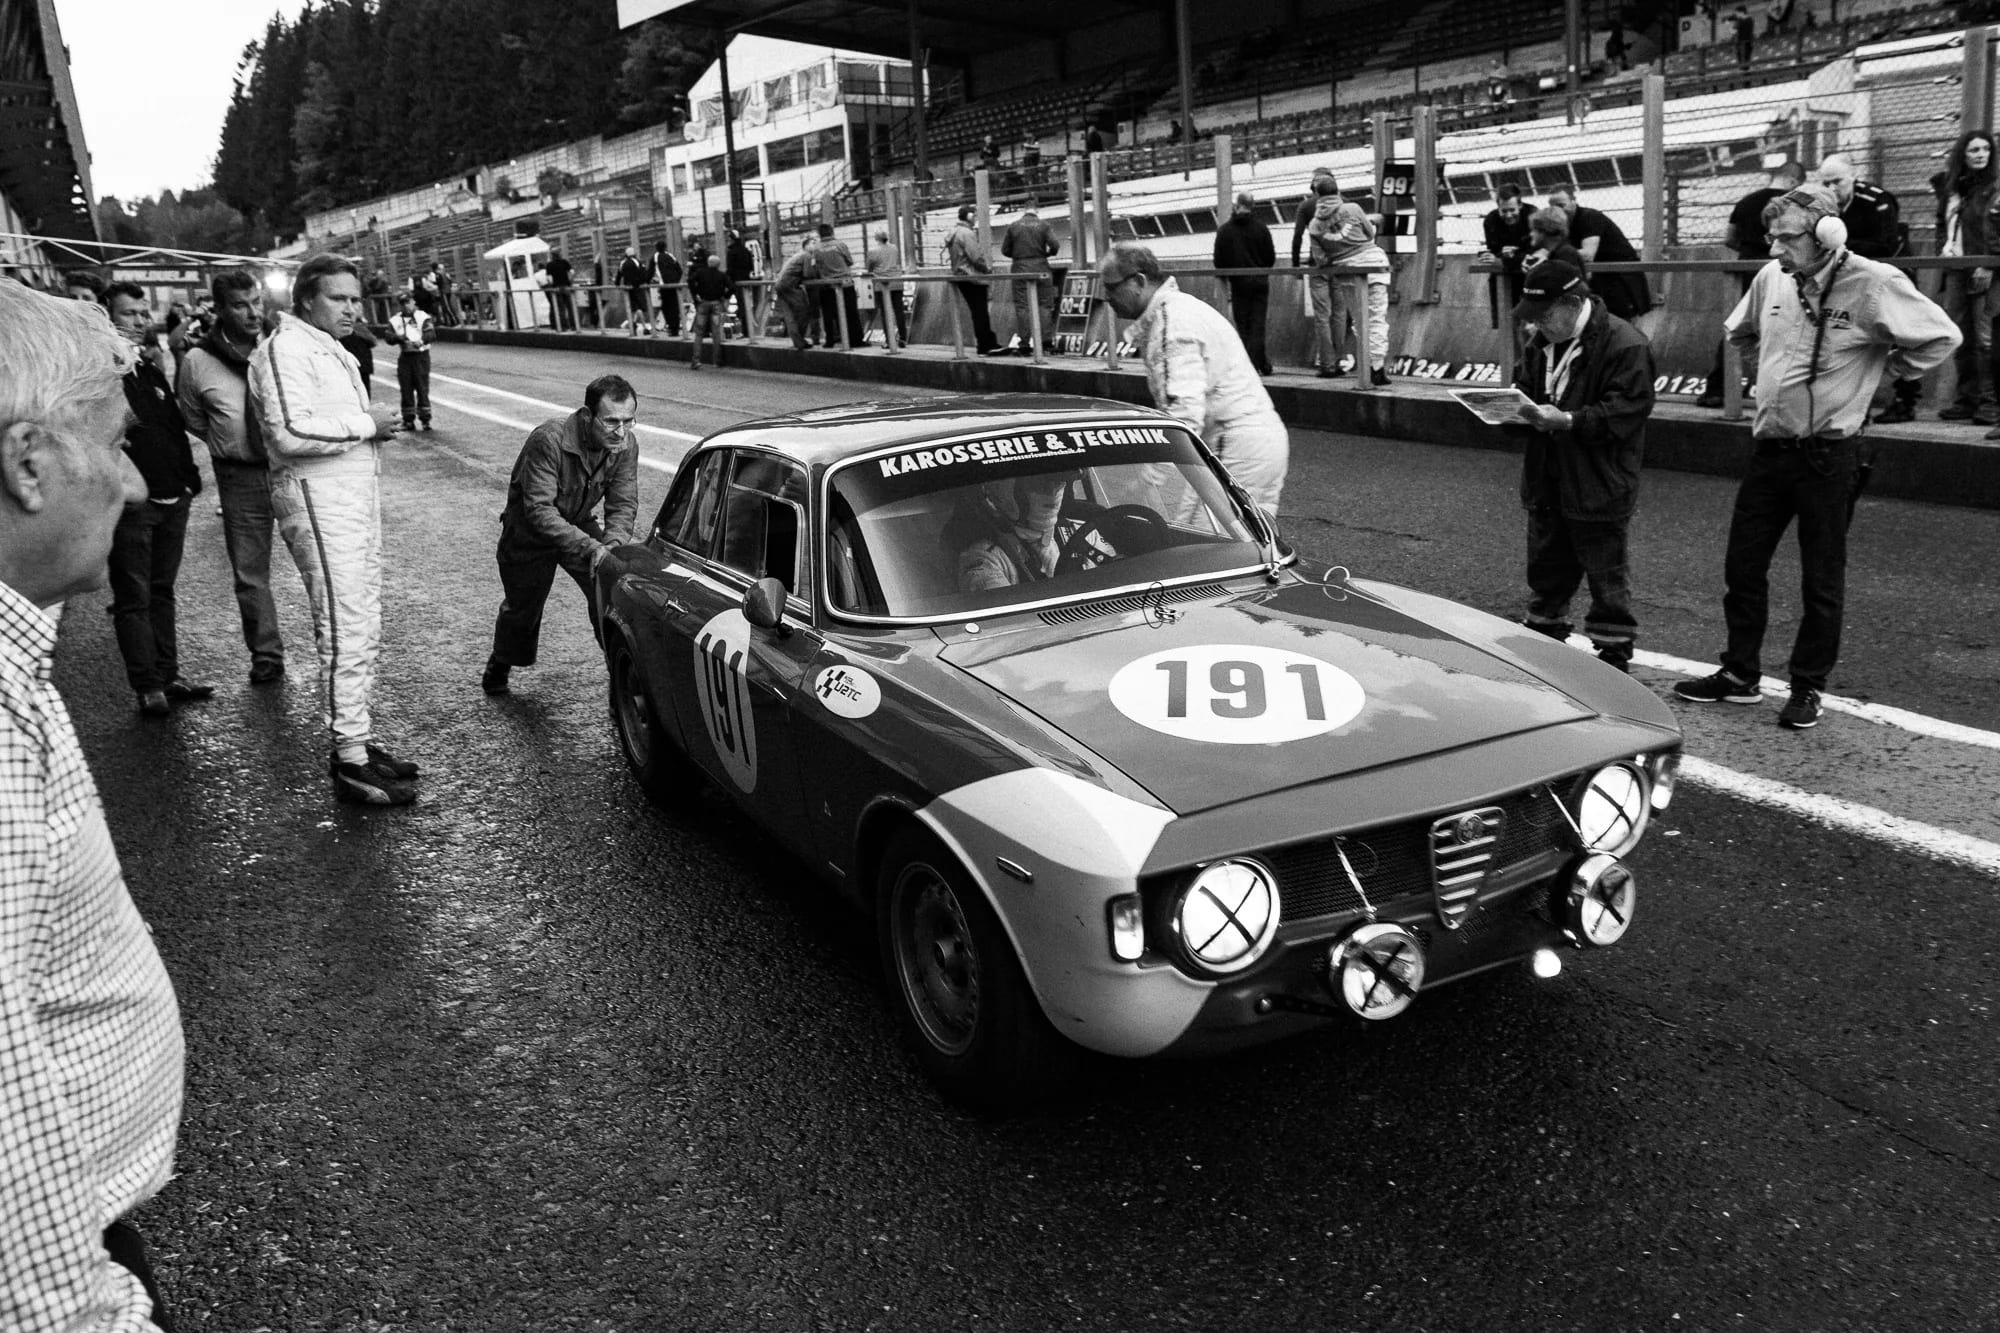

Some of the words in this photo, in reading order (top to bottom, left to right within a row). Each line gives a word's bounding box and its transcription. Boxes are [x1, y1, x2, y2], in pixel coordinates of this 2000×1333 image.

[879, 435, 1039, 478] KAROSSERIE
[1045, 433, 1068, 450] &
[1068, 429, 1170, 448] TECHNIK
[699, 632, 751, 768] 191
[834, 681, 862, 702] U2TC
[1155, 660, 1327, 721] 191
